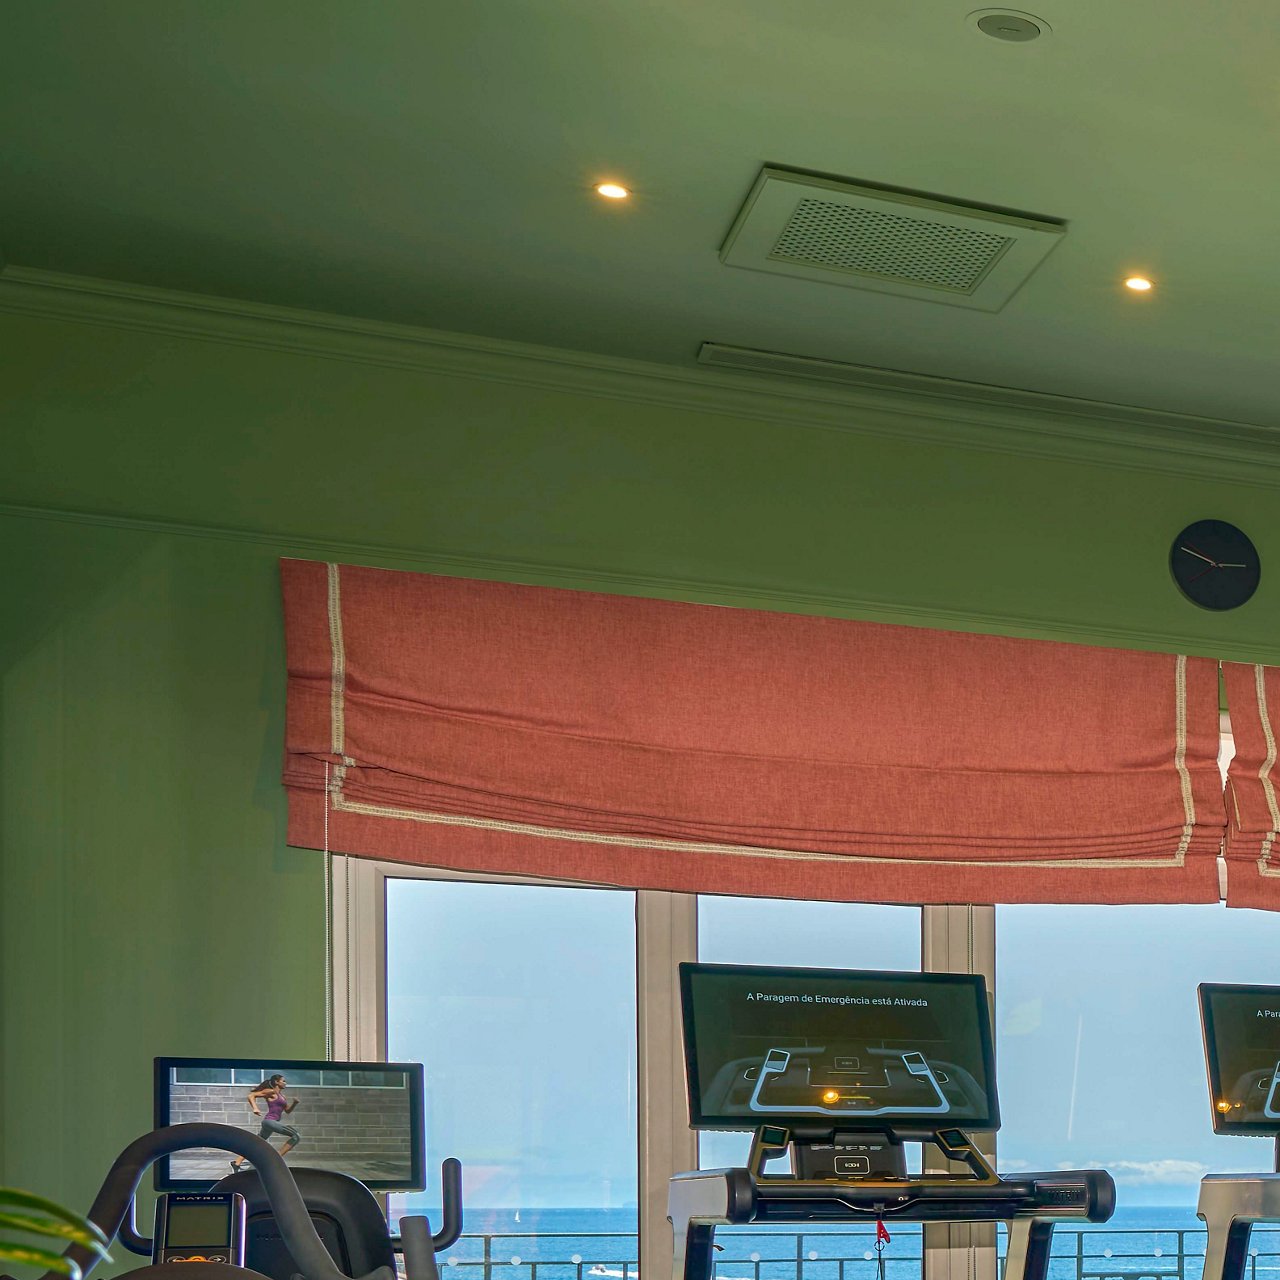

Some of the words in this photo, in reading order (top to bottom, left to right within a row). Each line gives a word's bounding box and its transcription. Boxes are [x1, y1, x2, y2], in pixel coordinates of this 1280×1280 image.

[746, 992, 754, 1001] A
[756, 992, 799, 1004] Paragem
[801, 994, 813, 1003] de
[815, 994, 870, 1006] Emergência
[872, 997, 892, 1006] está
[894, 998, 928, 1007] Ativada
[1256, 1010, 1264, 1018] A
